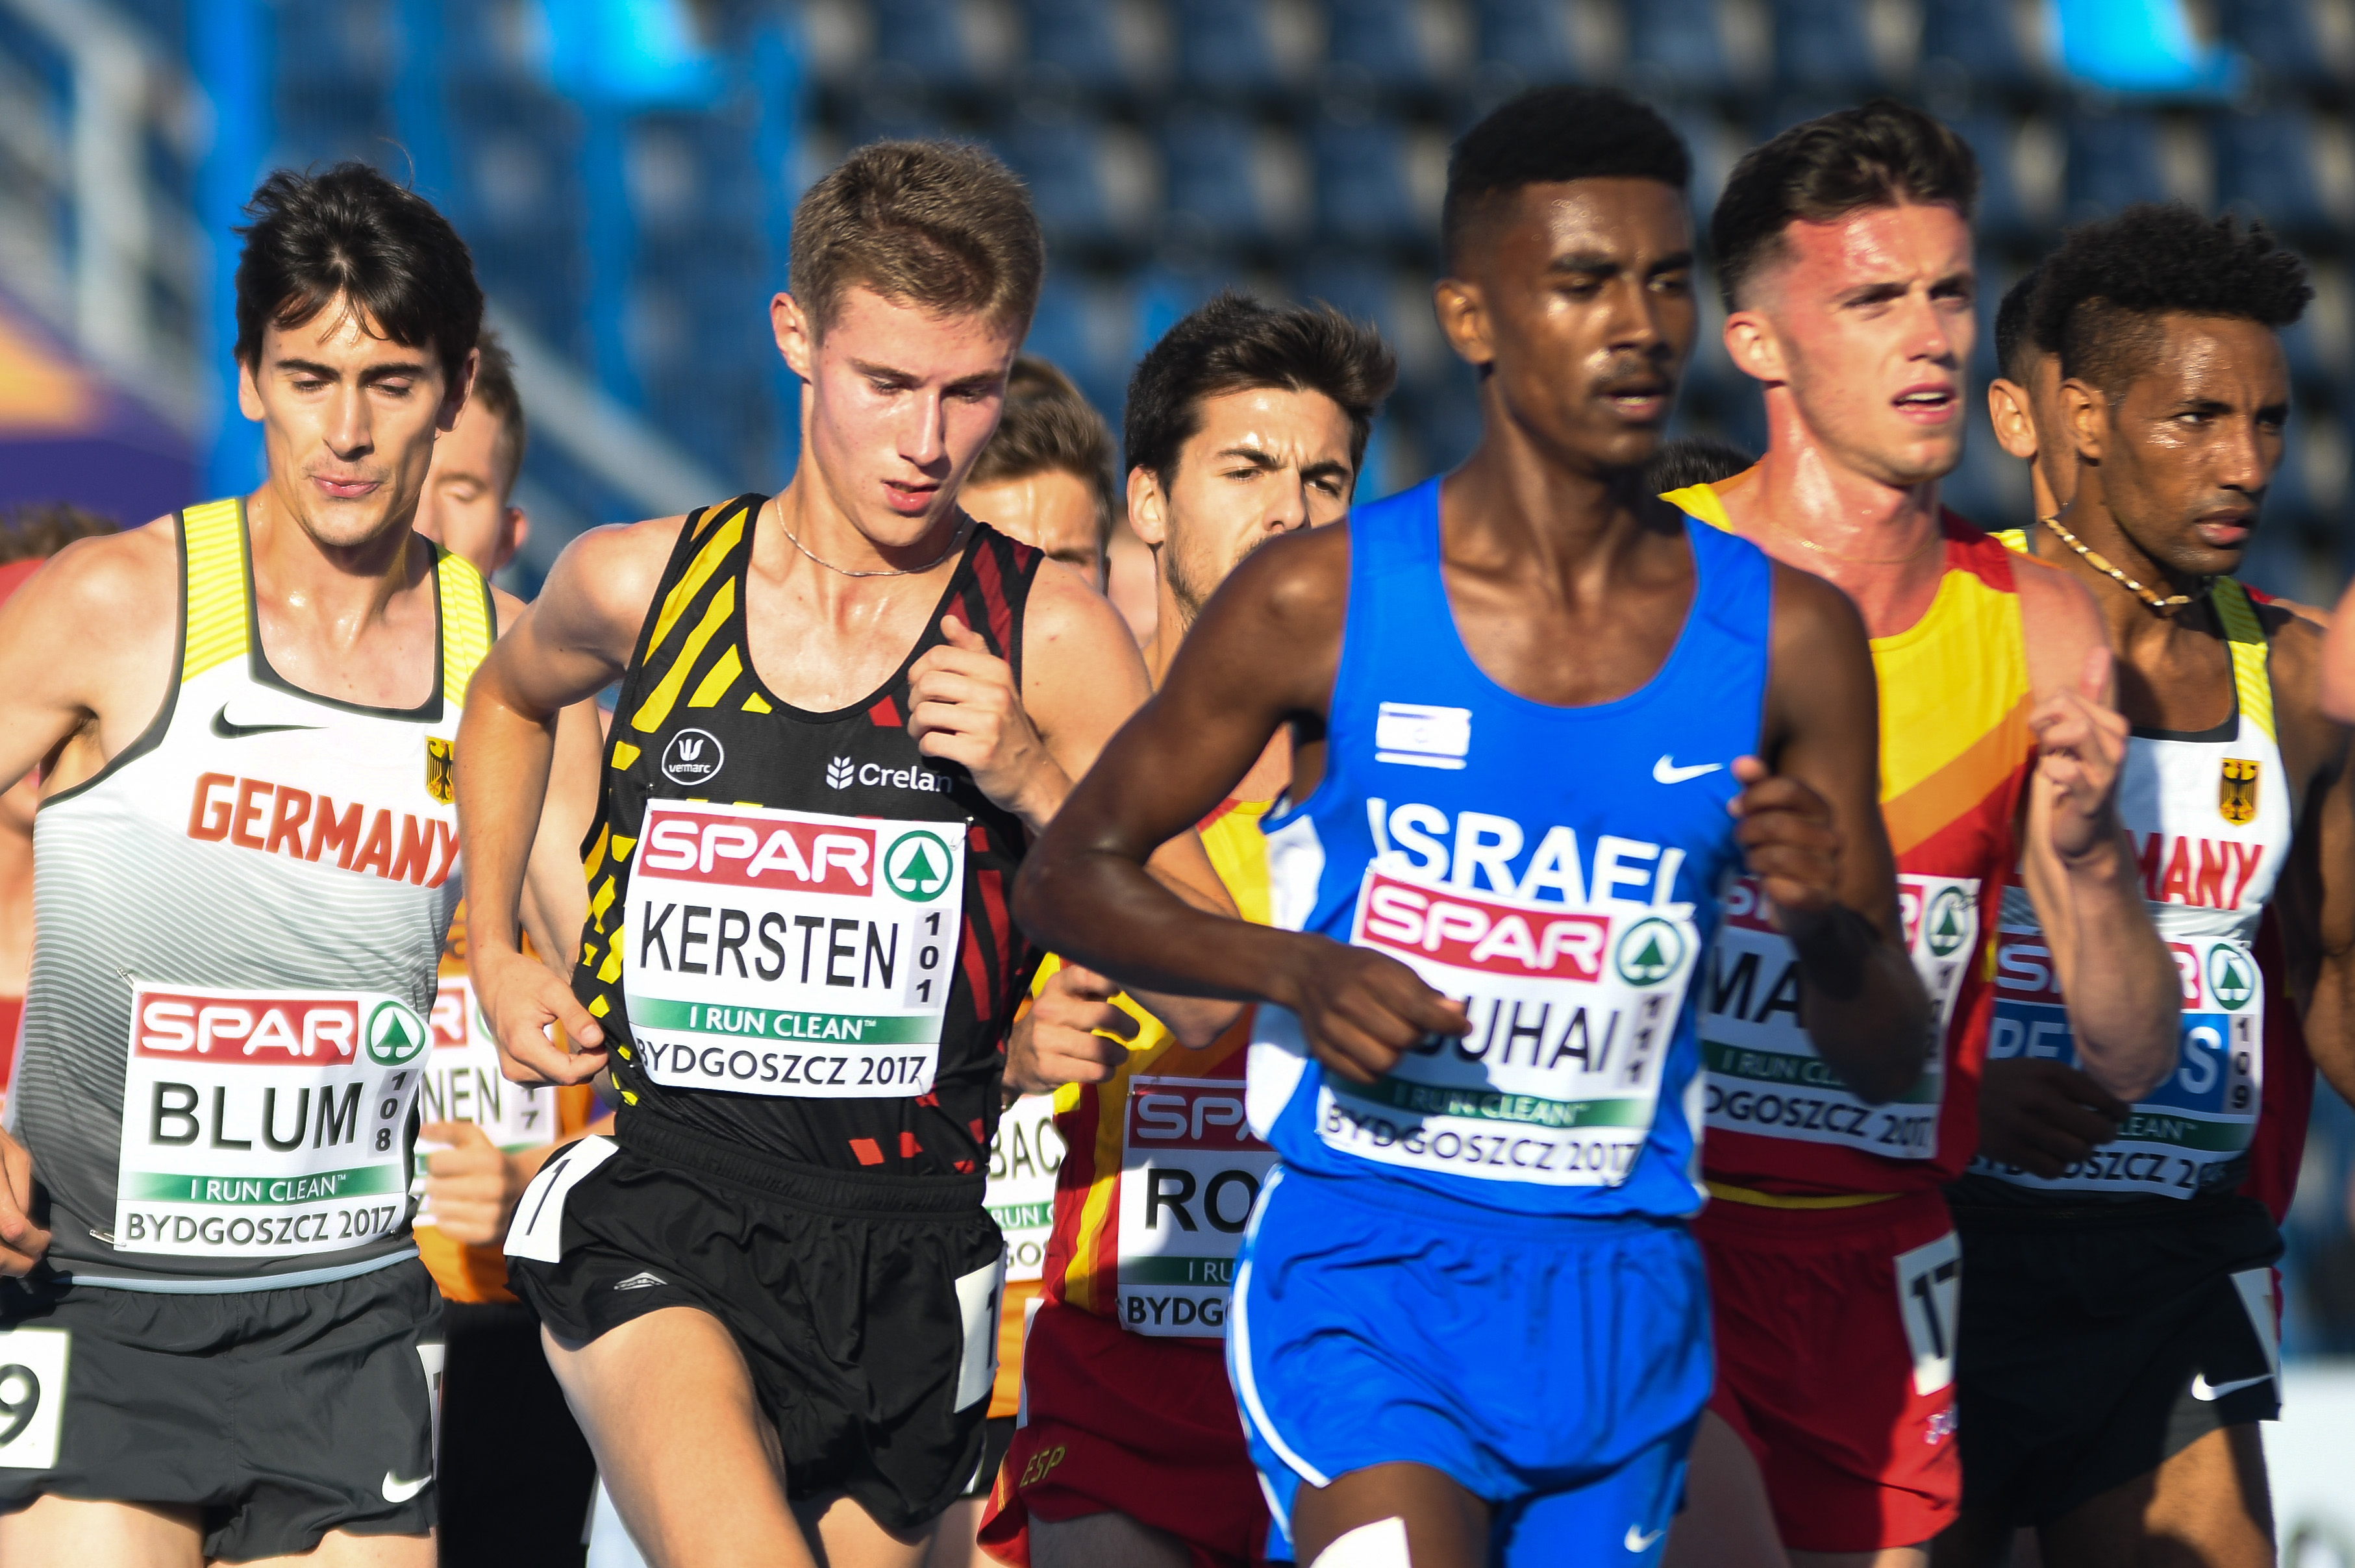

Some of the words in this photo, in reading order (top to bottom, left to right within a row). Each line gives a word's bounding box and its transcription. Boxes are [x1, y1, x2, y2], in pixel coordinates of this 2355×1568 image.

[668, 764, 712, 774] vemarc
[858, 763, 953, 793] Crelan
[186, 771, 459, 890] GERMANY
[645, 819, 869, 886] SPAR
[640, 901, 899, 990] KERSTEN
[1366, 884, 1604, 975] SPAR
[142, 1001, 352, 1057] SPAR
[690, 1006, 697, 1028] I
[705, 1007, 766, 1035] RUN
[1412, 995, 1621, 1073] UHAI
[636, 1037, 849, 1086] BYDGOSZCZ
[856, 1055, 928, 1086] 2017
[148, 1080, 364, 1152] BLUM
[1325, 1103, 1556, 1170] BYDGOSZCZ
[190, 1179, 197, 1200] I
[206, 1180, 260, 1202] RUN
[125, 1212, 329, 1246] BYDGOSZCZ
[337, 1205, 397, 1239] 2017
[991, 1206, 1040, 1228] RUN
[1188, 1262, 1194, 1281] I
[1127, 1295, 1229, 1327] BYDG
[1019, 1445, 1067, 1489] ESP
